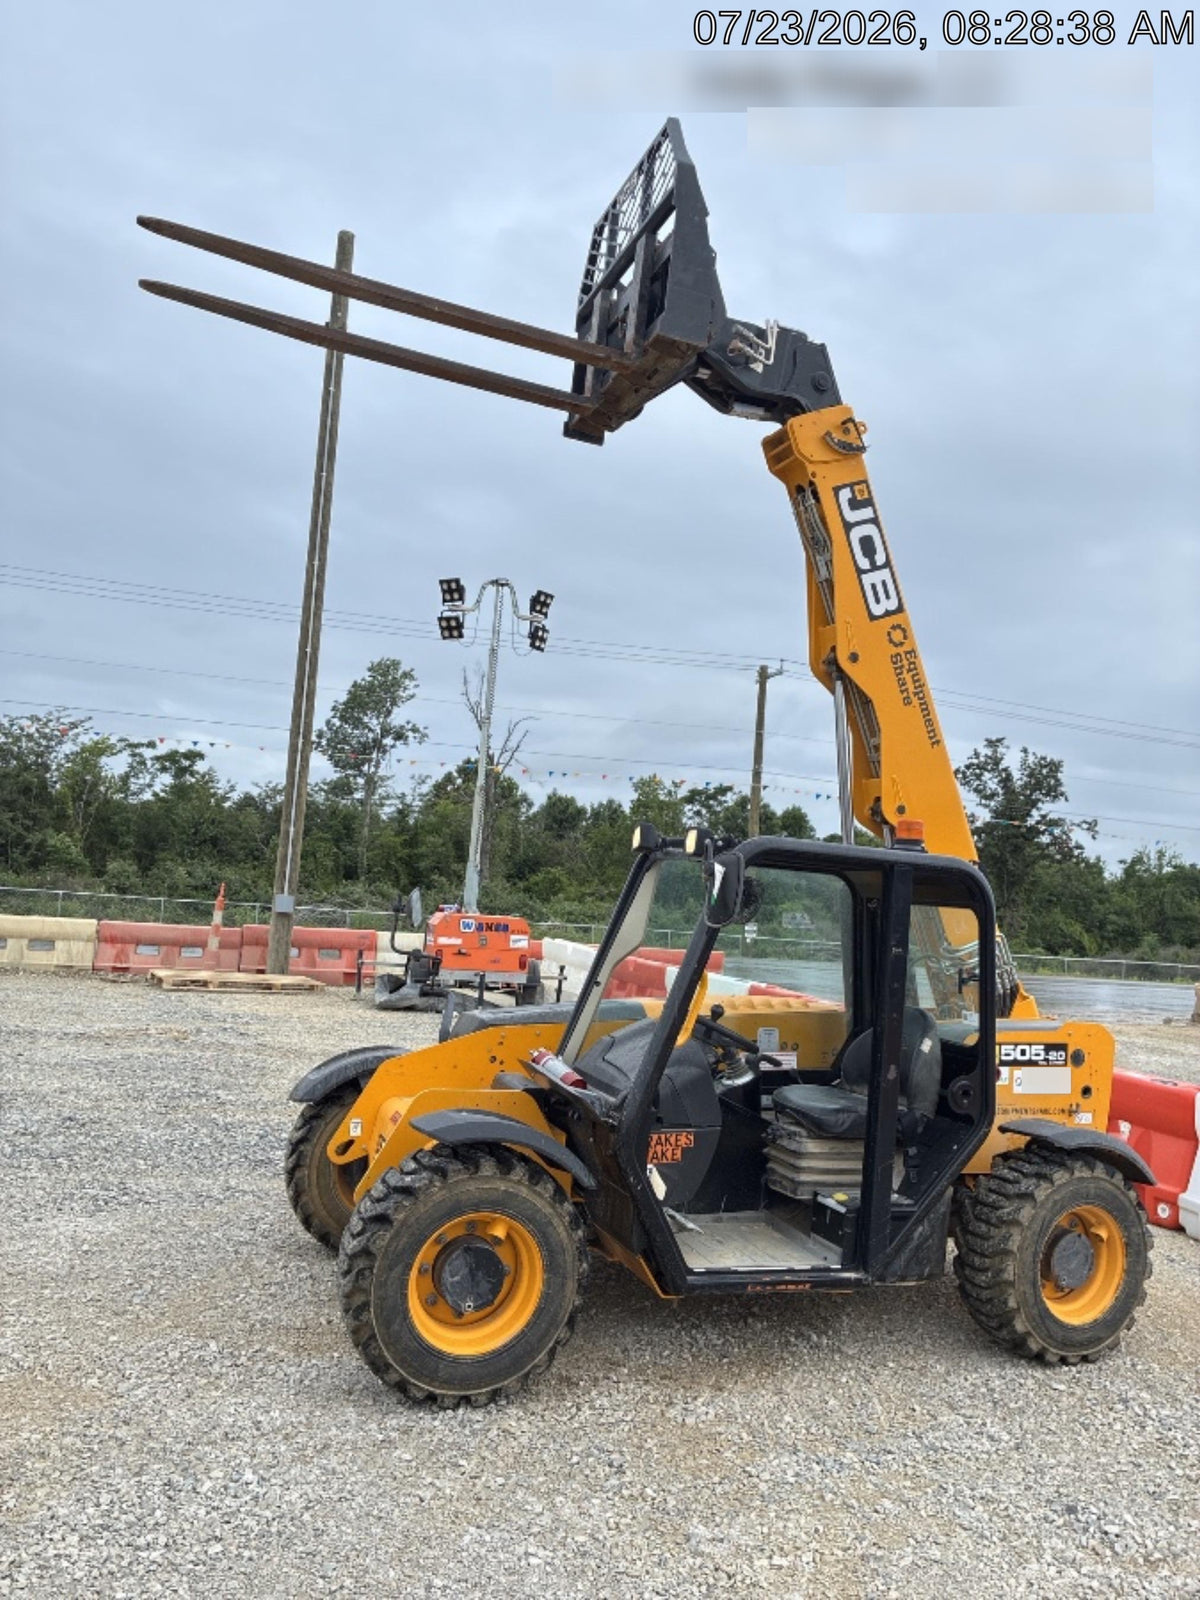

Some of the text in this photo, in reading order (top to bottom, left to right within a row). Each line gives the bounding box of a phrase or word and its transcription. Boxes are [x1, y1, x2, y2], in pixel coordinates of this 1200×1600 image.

[837, 486, 900, 617] JCB
[890, 652, 913, 707] Share
[903, 648, 941, 750] Equipment
